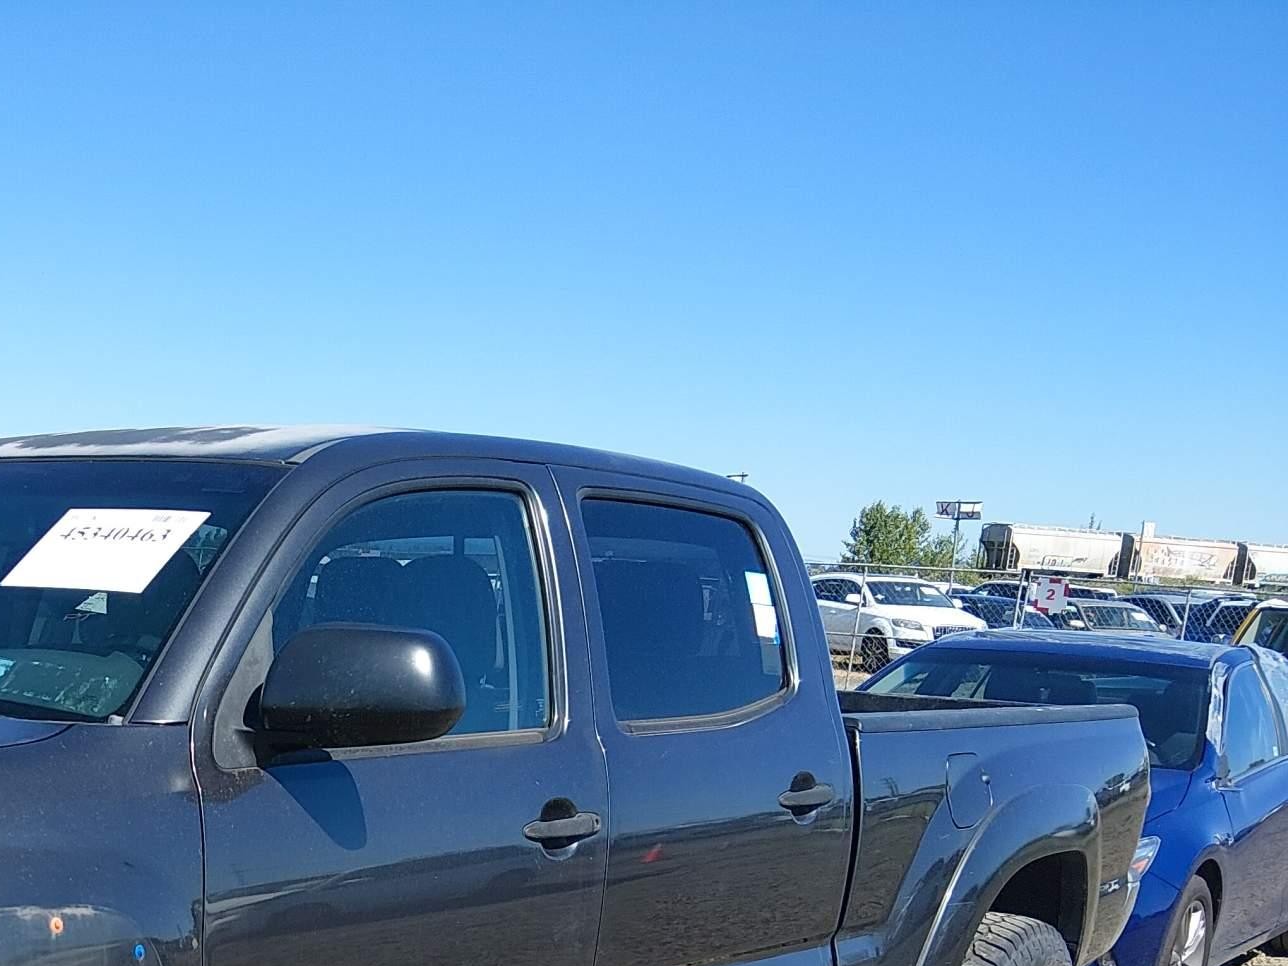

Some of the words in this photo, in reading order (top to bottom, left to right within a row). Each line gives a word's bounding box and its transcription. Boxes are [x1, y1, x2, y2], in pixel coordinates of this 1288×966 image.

[939, 502, 951, 517] K
[60, 526, 172, 542] 45340463
[1045, 588, 1056, 601] 2
